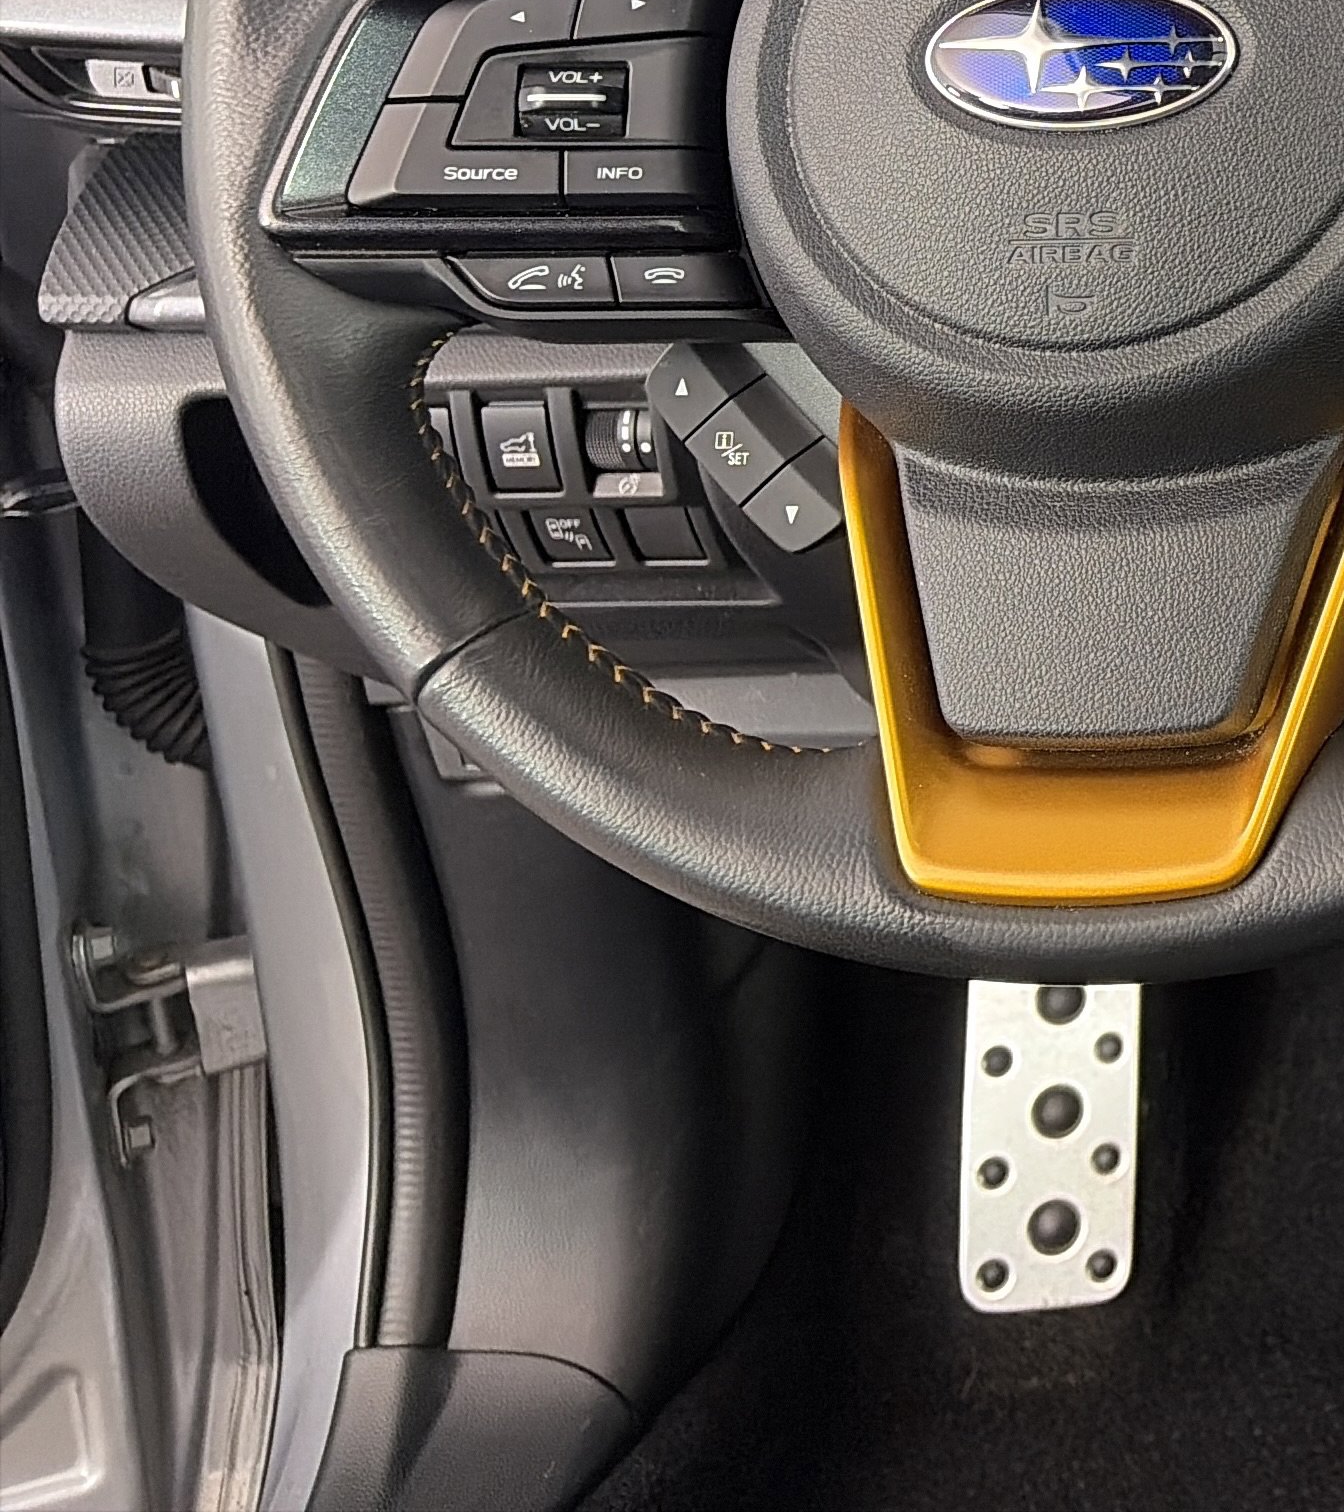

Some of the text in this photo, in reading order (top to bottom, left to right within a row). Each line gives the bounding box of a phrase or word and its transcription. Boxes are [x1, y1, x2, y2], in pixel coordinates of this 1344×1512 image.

[443, 166, 518, 181] Source
[596, 166, 643, 180] INFO
[1023, 211, 1120, 238] SRS
[1006, 244, 1134, 264] AIRBAG
[559, 518, 581, 530] OFF
